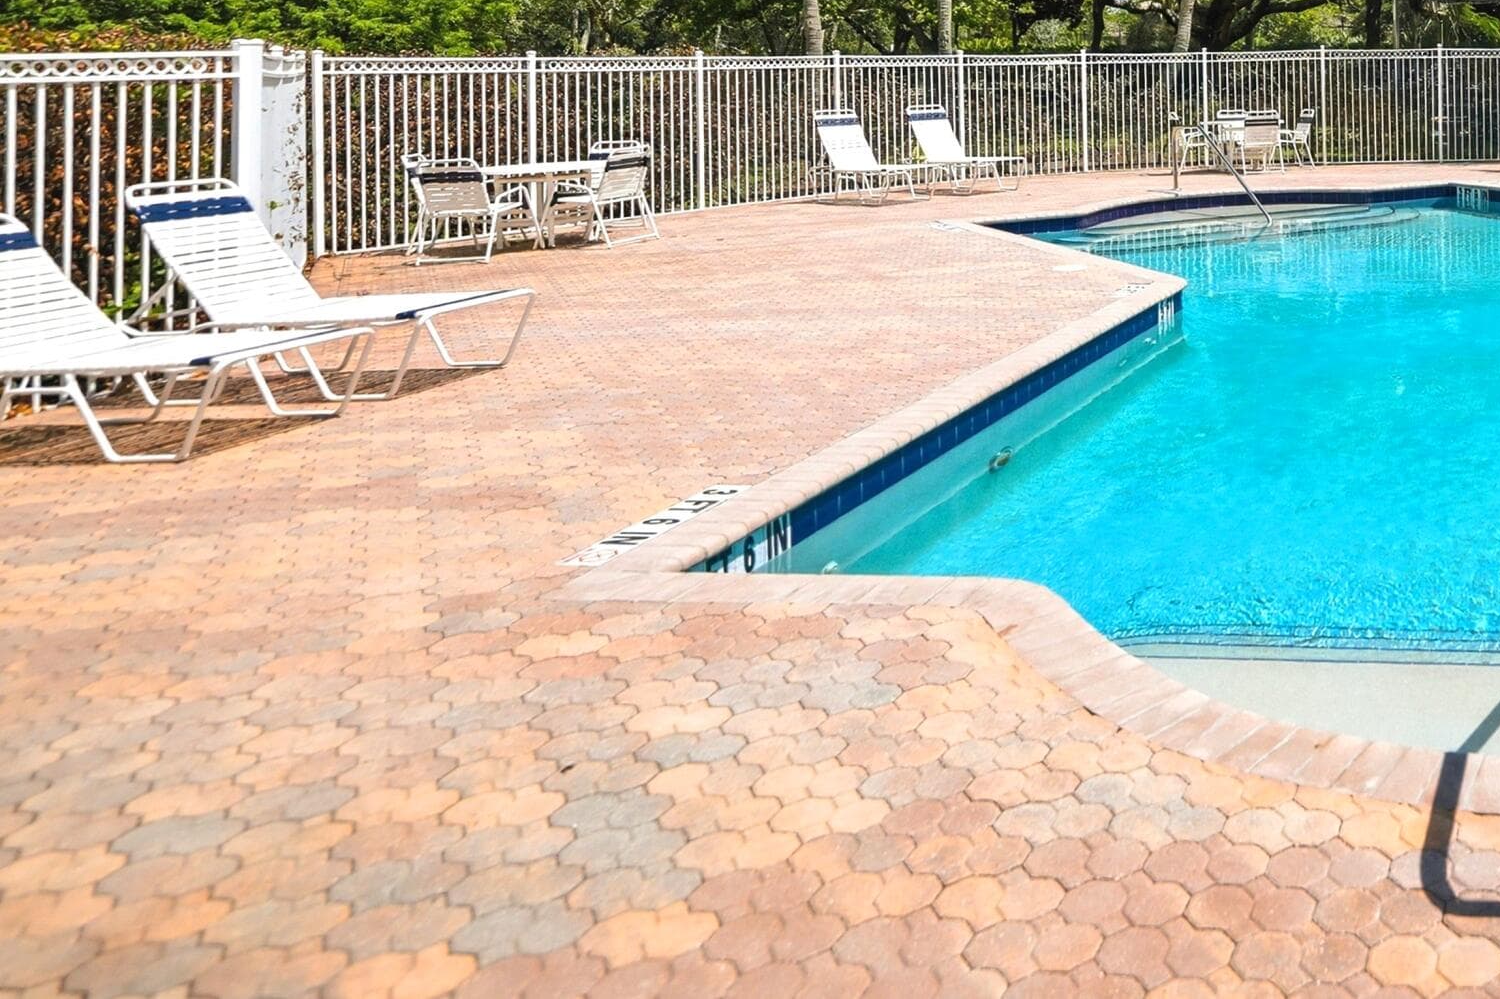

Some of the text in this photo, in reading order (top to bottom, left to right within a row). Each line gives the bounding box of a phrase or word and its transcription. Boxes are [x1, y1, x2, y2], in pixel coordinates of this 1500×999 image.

[600, 488, 738, 546] 3 FT 6 IN
[743, 535, 756, 573] 6
[766, 514, 790, 560] IN
